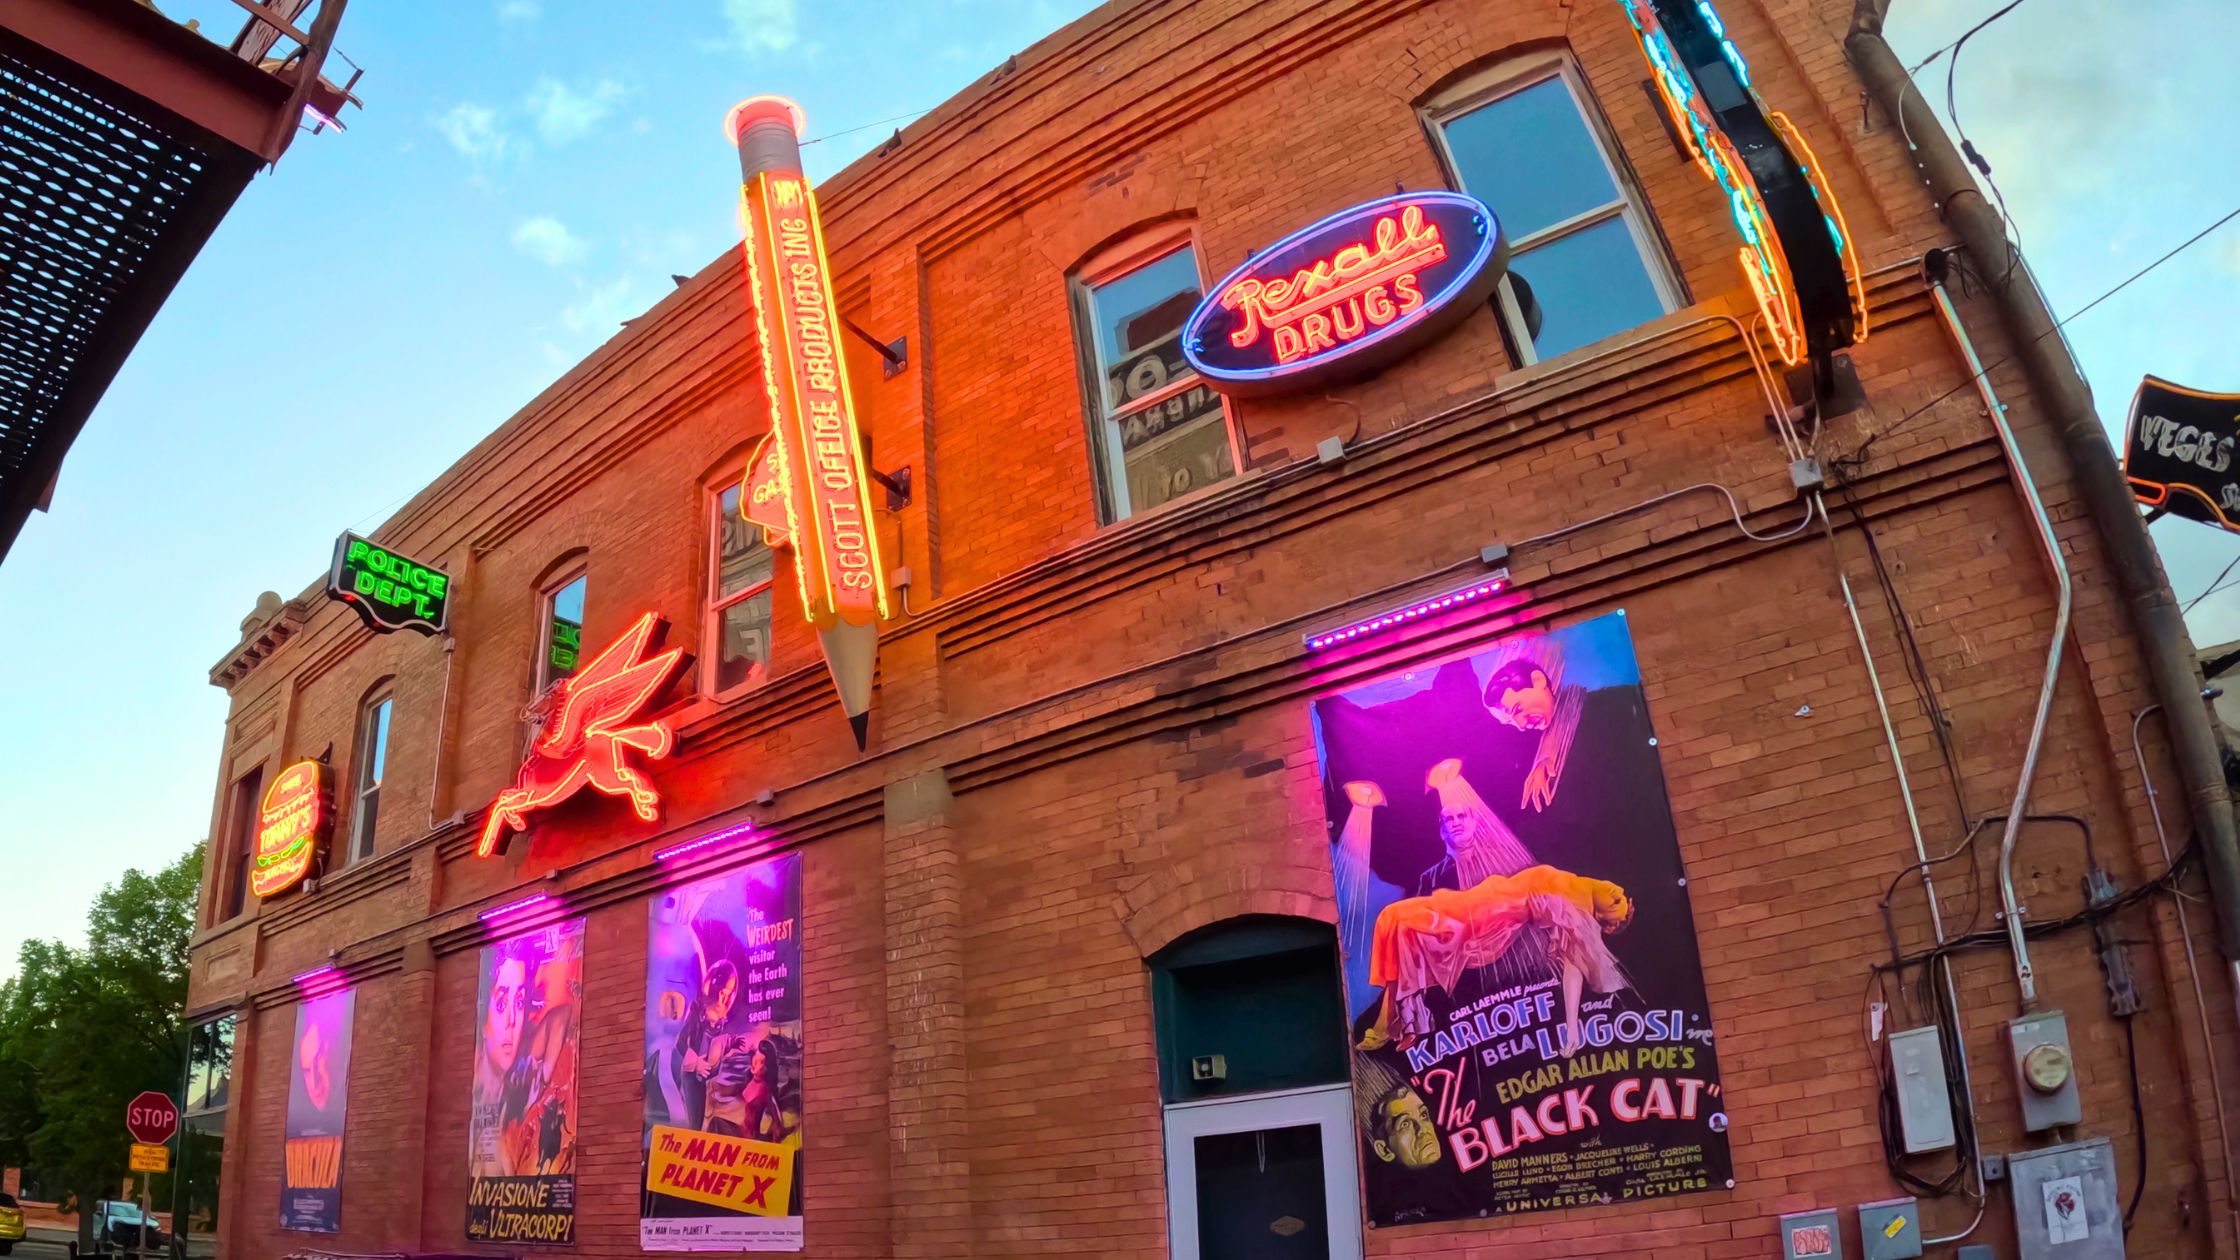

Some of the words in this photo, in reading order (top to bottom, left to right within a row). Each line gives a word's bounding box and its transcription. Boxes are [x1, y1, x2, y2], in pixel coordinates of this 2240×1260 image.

[780, 217, 811, 259] INC
[1220, 206, 1440, 347] Rexall
[791, 262, 837, 392] PRODUCTS
[1273, 274, 1423, 363] DRUGS
[809, 400, 852, 490] OFFICE
[2140, 415, 2235, 472] VEGES
[827, 499, 872, 589] SCOTT
[347, 541, 447, 599] POLICE
[354, 569, 435, 619] DEPT.
[746, 918, 794, 949] WEIRDEST
[748, 907, 764, 922] The
[748, 949, 776, 965] visitor
[748, 969, 762, 984] the
[764, 963, 787, 981] Earth
[748, 988, 763, 1004] has
[765, 987, 785, 1001] ever
[748, 1006, 772, 1023] seen!
[1449, 1005, 1473, 1021] CARL
[1473, 985, 1522, 1011] LAEMMLE
[1406, 991, 1556, 1073] KARLOFF
[1581, 993, 1615, 1012] and
[1482, 1033, 1536, 1067] BELA
[1536, 1010, 1683, 1061] LUGOSI
[1495, 1064, 1564, 1104] EDGAR
[1568, 1049, 1629, 1081] ALLAN
[1637, 1045, 1696, 1070] POE'S
[131, 1107, 174, 1128] STOP
[1448, 1084, 1599, 1173] BLACK
[659, 1132, 682, 1153] The
[681, 1138, 741, 1168] MAN
[741, 1151, 780, 1171] FROM
[1492, 1158, 1519, 1171] DAVID
[1521, 1152, 1569, 1167] MANNERS
[1633, 1160, 1660, 1171] LOUIS
[1660, 1144, 1702, 1158] CORDING
[468, 1175, 550, 1208] INVASIONE
[660, 1163, 744, 1198] PLANET
[742, 1174, 777, 1209] X
[1623, 1178, 1707, 1198] PICTURE
[489, 1208, 574, 1241] ULTRACORPI
